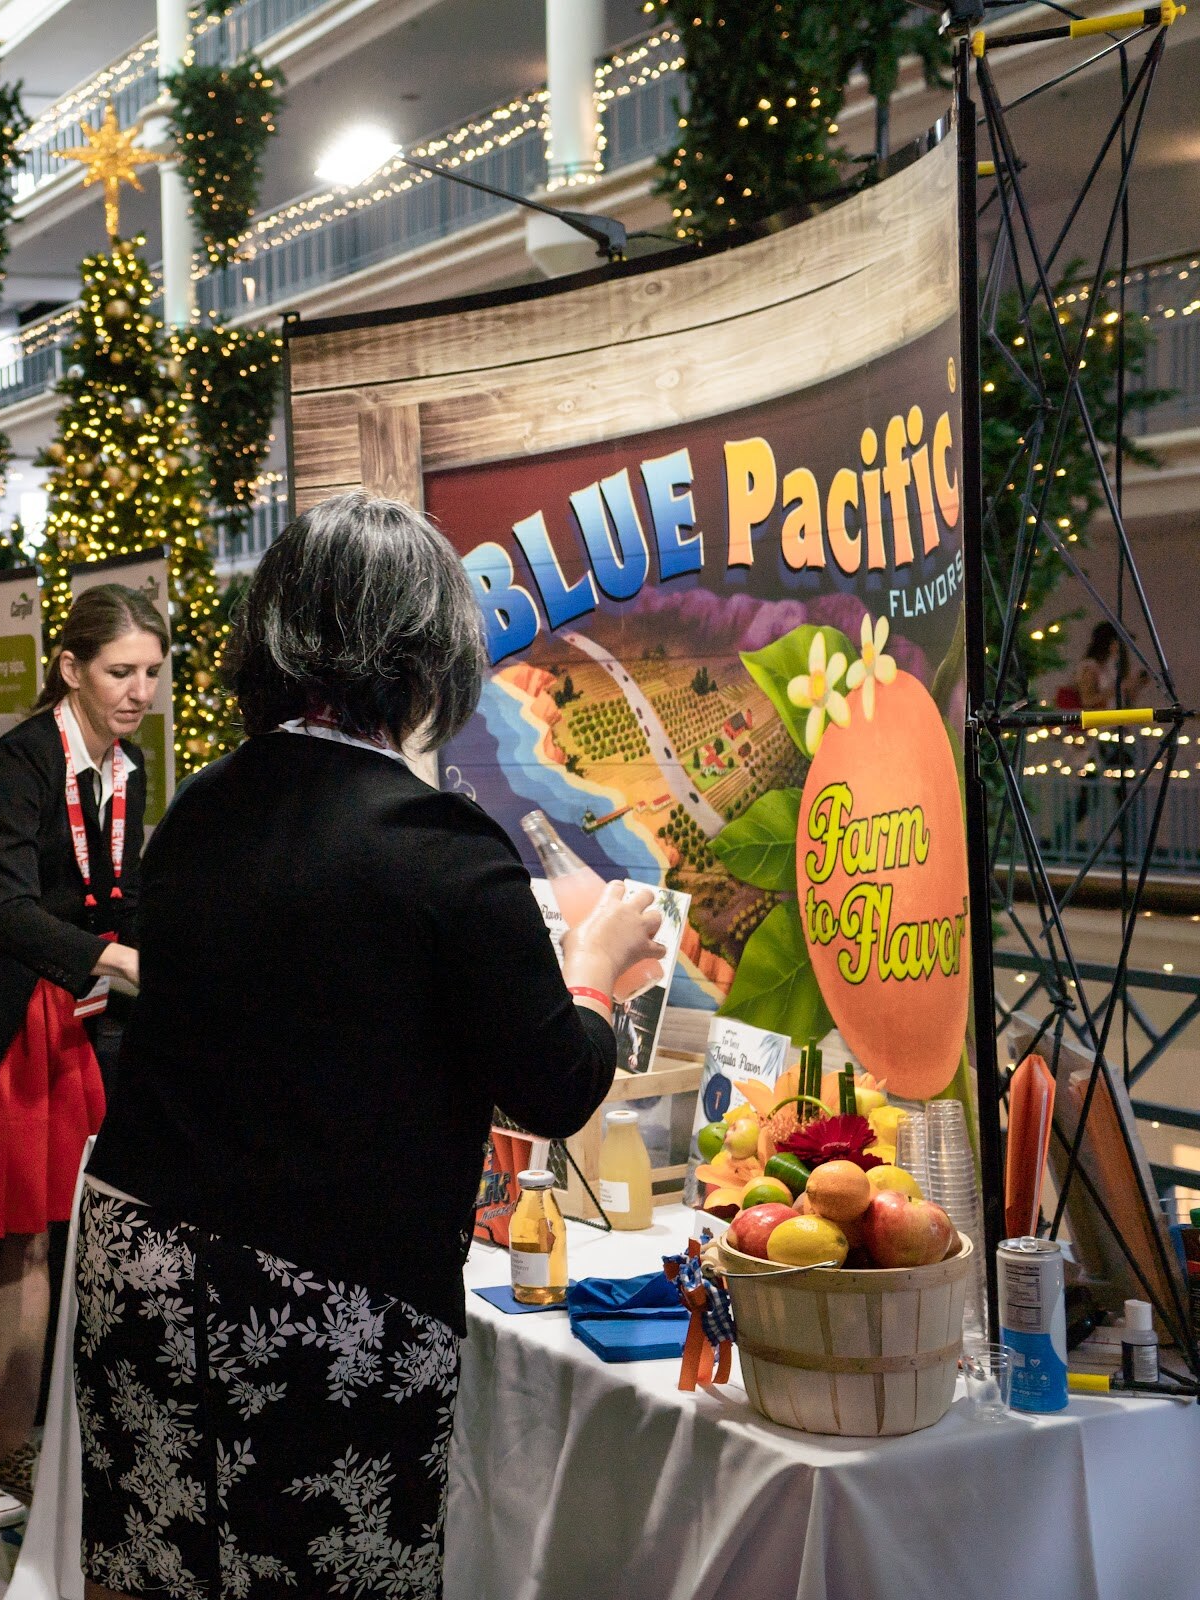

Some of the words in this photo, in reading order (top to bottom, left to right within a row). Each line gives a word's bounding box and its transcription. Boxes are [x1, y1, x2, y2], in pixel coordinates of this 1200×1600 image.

[461, 448, 705, 666] BLUE
[723, 404, 960, 575] Pacific
[889, 549, 963, 618] FLAVORS
[111, 818, 125, 871] BEVNET
[805, 781, 931, 884] Farm
[805, 885, 839, 946] to
[836, 881, 966, 985] Flavor
[738, 1052, 761, 1076] Flavor
